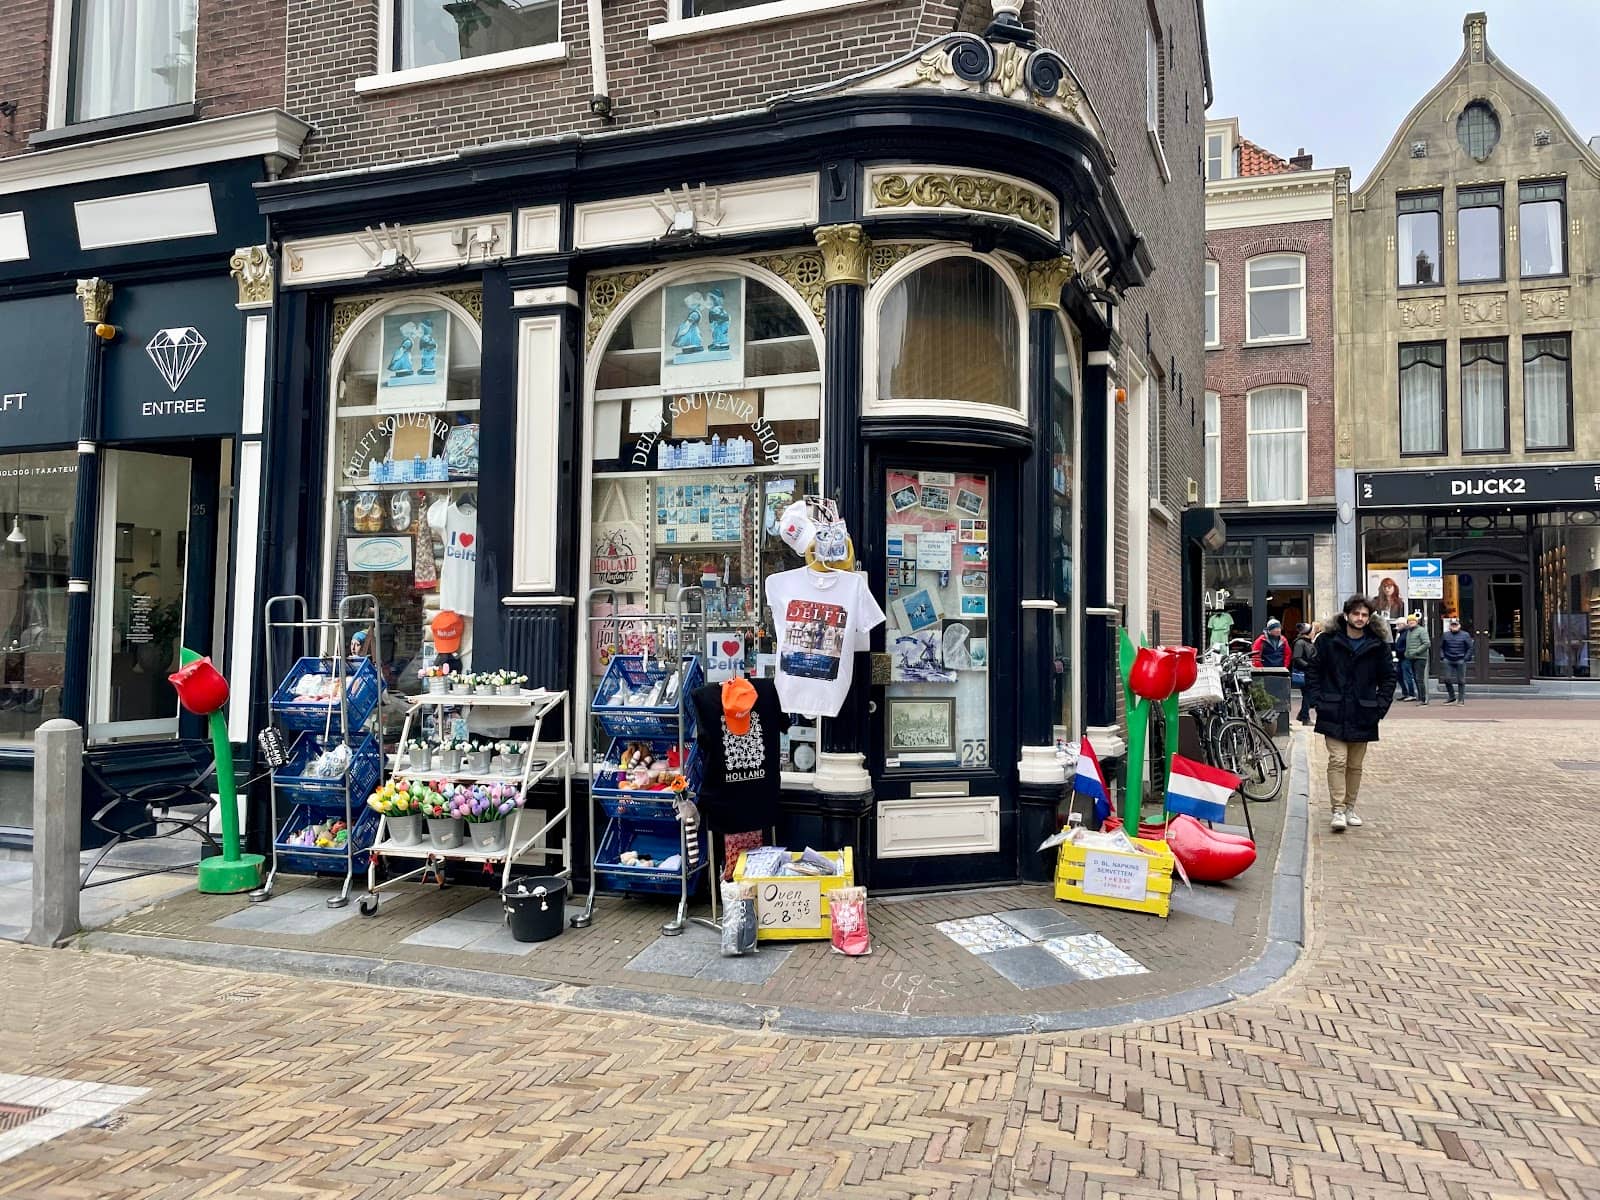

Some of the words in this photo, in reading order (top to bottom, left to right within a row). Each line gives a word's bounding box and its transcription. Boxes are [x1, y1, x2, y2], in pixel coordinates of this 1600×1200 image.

[0, 392, 28, 412] FT
[142, 399, 206, 416] ENTREE
[668, 391, 754, 424] SOUVENIR
[377, 407, 449, 440] SOUVENIR
[0, 468, 30, 477] OLOOG
[1363, 488, 1373, 498] 2
[1451, 478, 1526, 496] DIJCK2
[192, 503, 206, 516] 25
[451, 531, 456, 546] I
[594, 556, 637, 573] HOLLAND
[789, 606, 846, 624] DELFT
[712, 641, 718, 657] I
[706, 658, 745, 670] Delft
[962, 743, 987, 763] 23
[725, 769, 766, 781] HOLLAND
[764, 884, 802, 902] Oven
